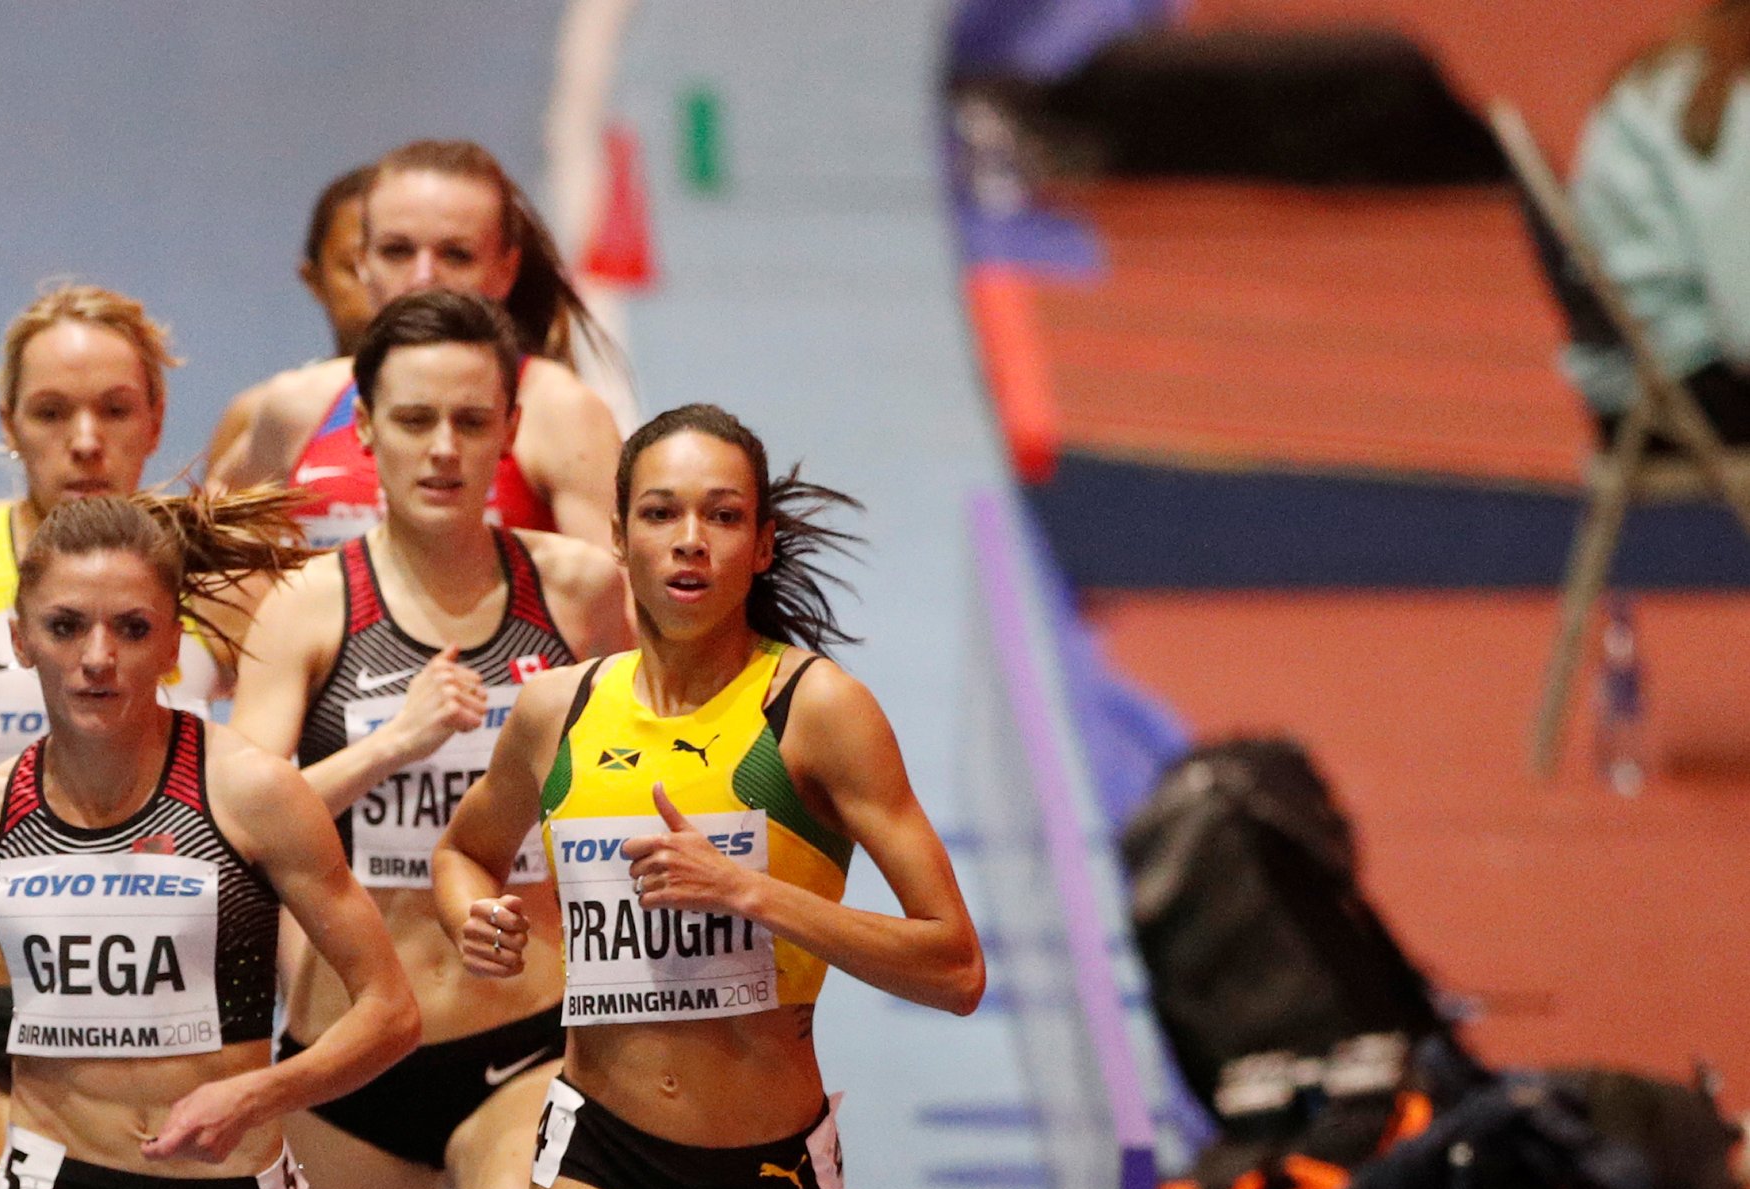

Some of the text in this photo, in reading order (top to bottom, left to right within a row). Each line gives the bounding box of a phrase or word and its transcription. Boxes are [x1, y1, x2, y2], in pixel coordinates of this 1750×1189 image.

[7, 874, 205, 898] TOYO TIRES
[22, 934, 186, 996] GEGA
[568, 981, 769, 1017] BIRMINGHAM 2018
[18, 1020, 213, 1047] BIRMINGHAM 2018
